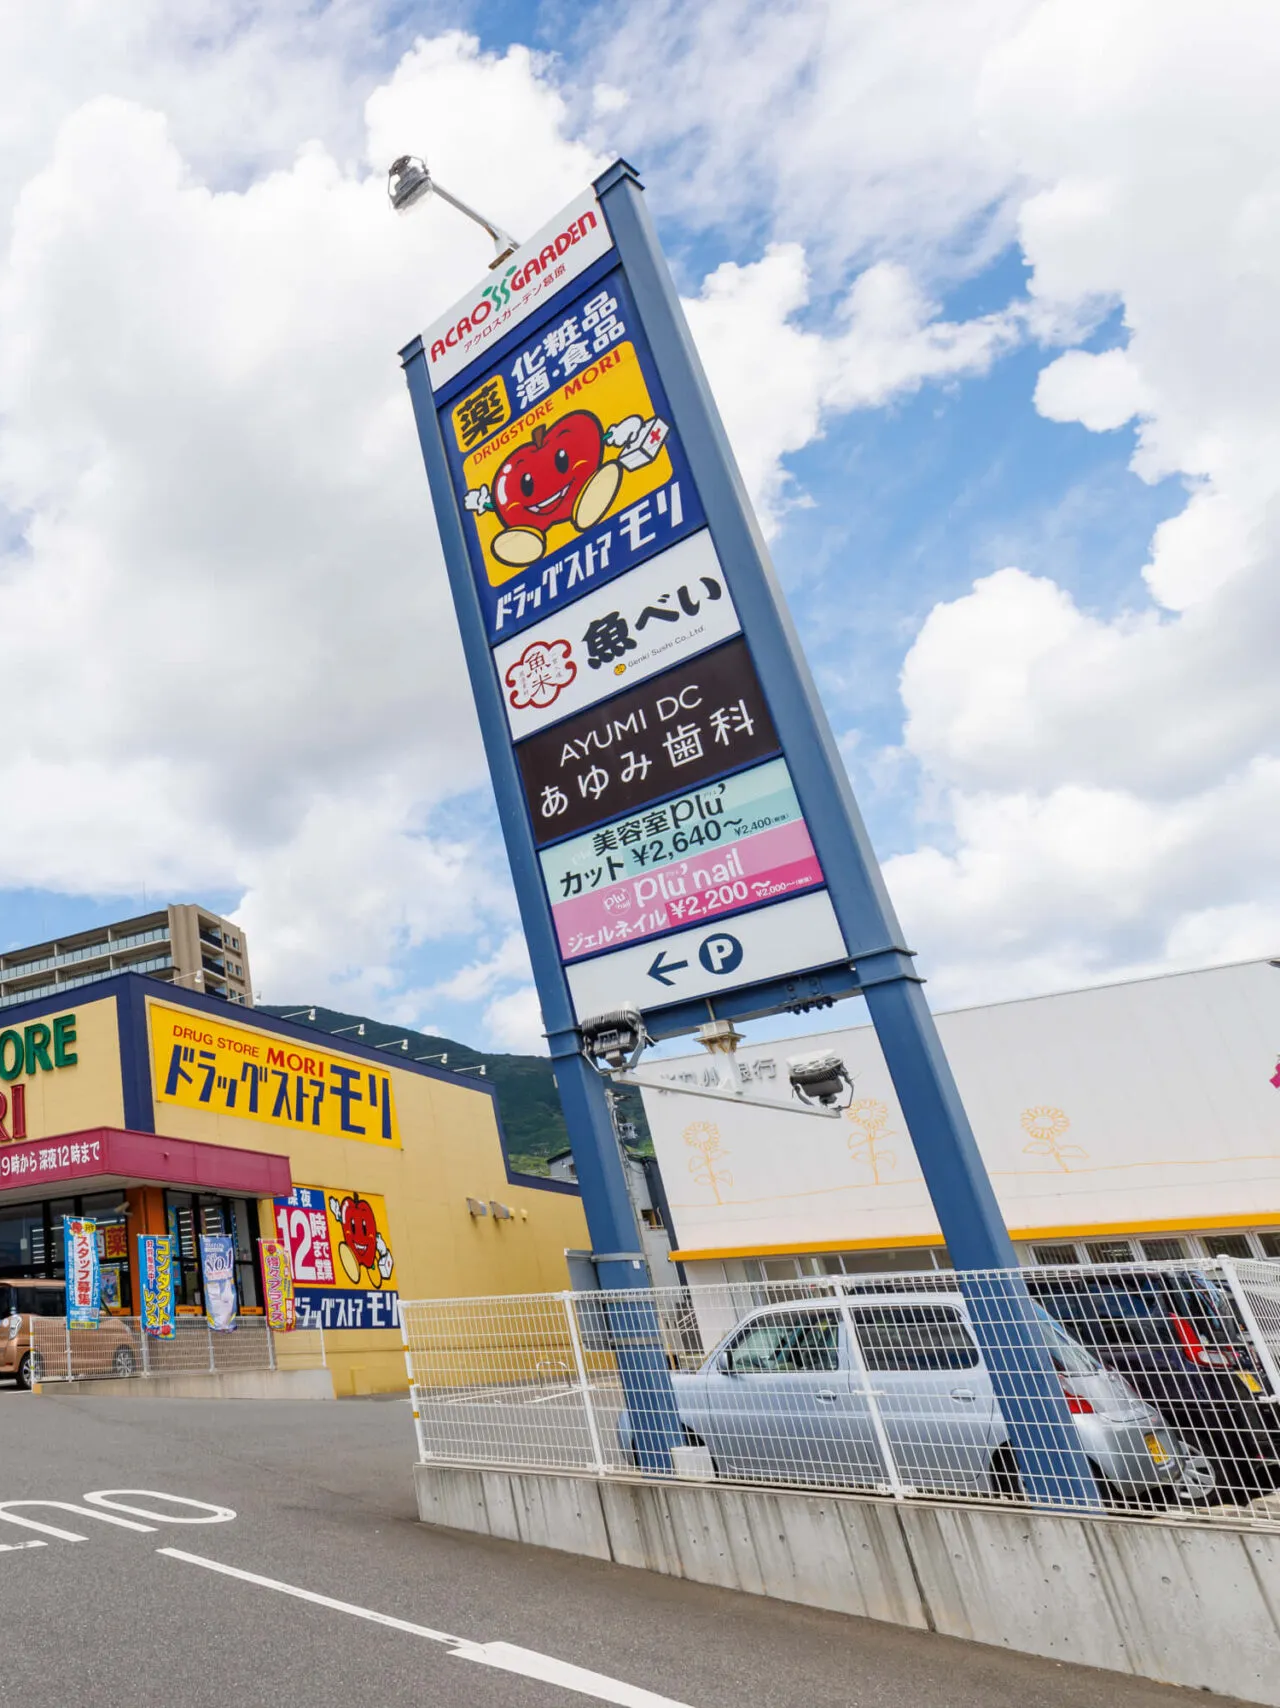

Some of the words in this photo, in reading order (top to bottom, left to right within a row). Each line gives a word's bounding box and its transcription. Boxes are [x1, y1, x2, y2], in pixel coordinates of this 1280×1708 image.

[511, 290, 619, 384] 化粧品
[456, 380, 506, 447] 薬
[473, 399, 554, 465] DRUGSTORE
[564, 349, 622, 400] MORI
[581, 576, 722, 670] 魚べい
[540, 699, 755, 818] あゆみ歯科
[559, 708, 648, 767] AYUMI
[655, 684, 704, 722] DC
[560, 855, 625, 897] カット
[567, 909, 668, 953] ジェルネイル
[173, 1024, 213, 1046] DRUG
[217, 1037, 260, 1058] STORE
[266, 1047, 324, 1077] MORI
[156, 1239, 171, 1327] コンタクト
